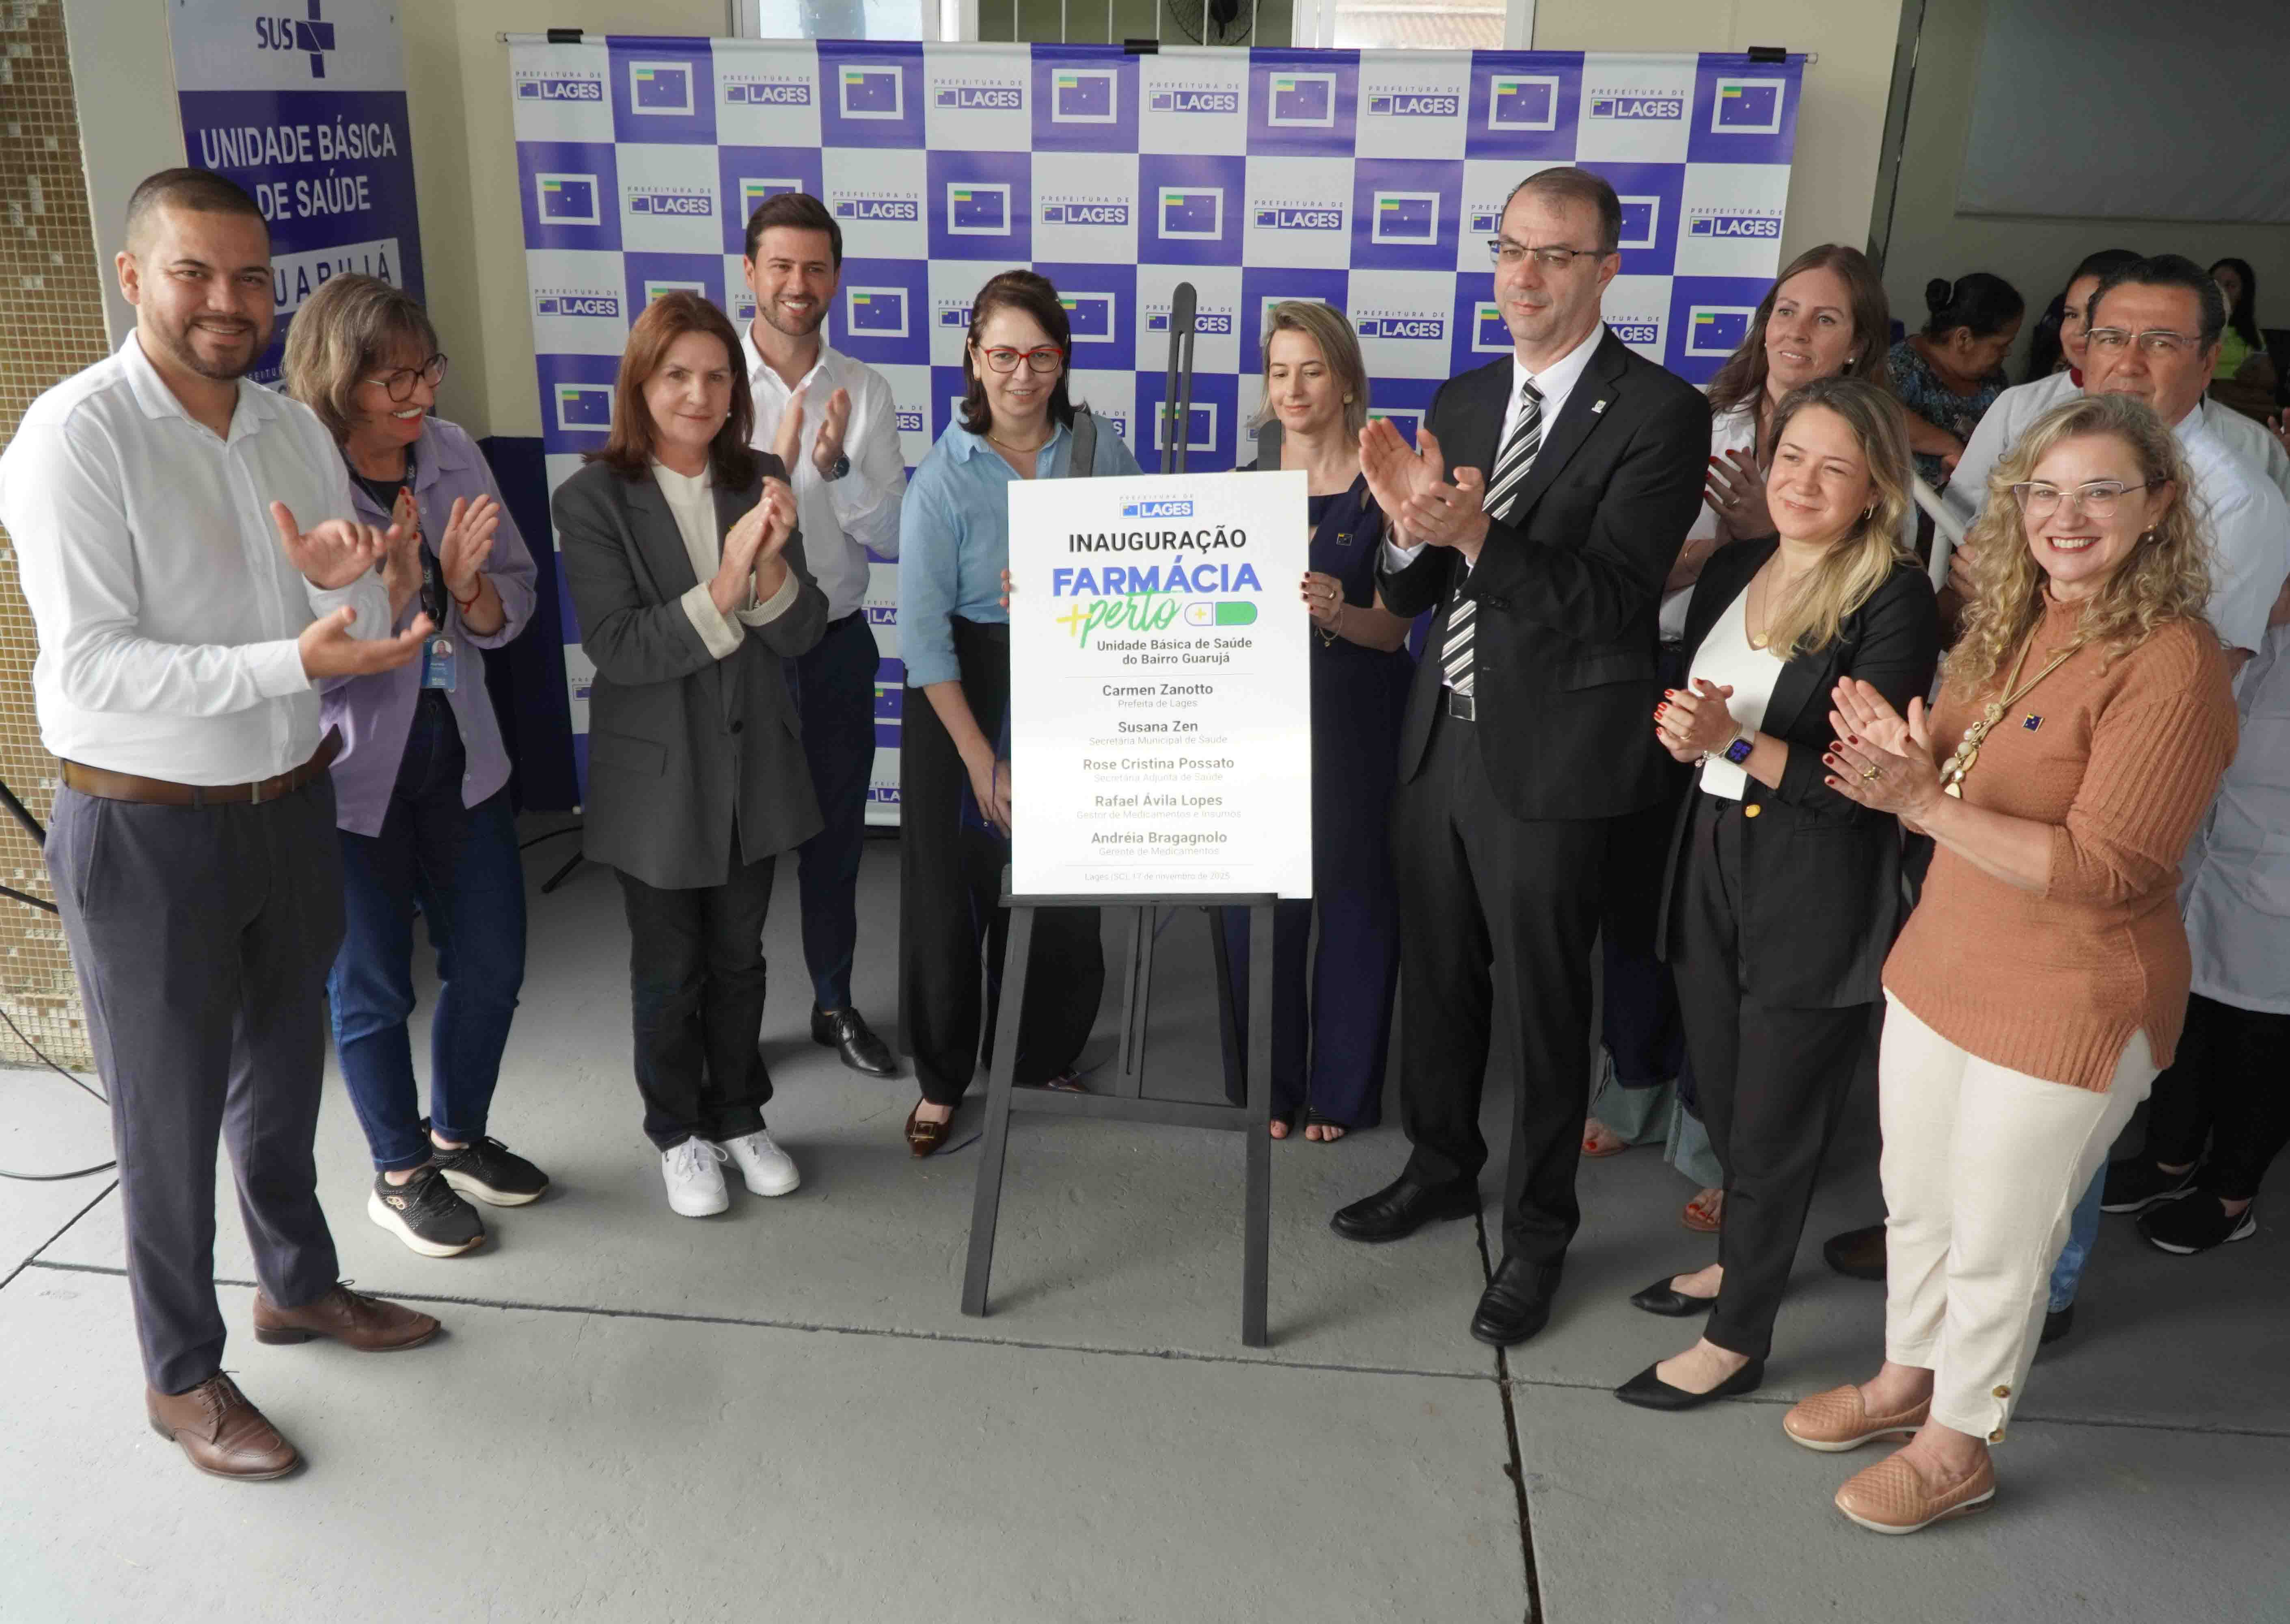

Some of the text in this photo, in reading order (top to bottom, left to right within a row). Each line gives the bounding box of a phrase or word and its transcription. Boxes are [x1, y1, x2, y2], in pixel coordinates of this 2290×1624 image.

[256, 17, 293, 50] SUS
[543, 82, 599, 98] LAGES
[750, 87, 807, 102] LAGES
[961, 91, 1019, 106] LAGES
[1176, 94, 1235, 110] LAGES
[1395, 98, 1455, 114] LAGES
[1618, 102, 1679, 117] LAGES
[201, 115, 397, 169] UNIDADE BÁSICA
[257, 168, 371, 221] DE SAÚDE
[654, 198, 709, 213] LAGES
[859, 203, 915, 218] LAGES
[1068, 207, 1125, 222] LAGES
[1281, 212, 1338, 227] LAGES
[1716, 220, 1776, 236] LAGES
[562, 300, 616, 314] LAGES
[1195, 317, 1228, 332] GES
[1382, 322, 1440, 337] LAGES
[1141, 503, 1191, 517] LAGES
[1070, 525, 1246, 554] INAUGURAÇÃO
[1053, 555, 1263, 597] FARMÁCIA
[1098, 637, 1252, 651] Unidade Básica de Saúde
[1123, 652, 1229, 665] do Bairro Guarujá
[1103, 684, 1213, 696] Carmen Zanotto
[1170, 700, 1198, 708] Lages
[1119, 721, 1198, 732] Susana Zen
[1138, 736, 1182, 745] Municipal
[1083, 758, 1234, 770] Rose Cristina Possato
[1143, 773, 1177, 783] Adjunta
[1096, 793, 1222, 808] Rafael Ávila Lopes
[1124, 810, 1190, 818] Medicamentos
[1091, 831, 1227, 846] Andréia Bragagnolo
